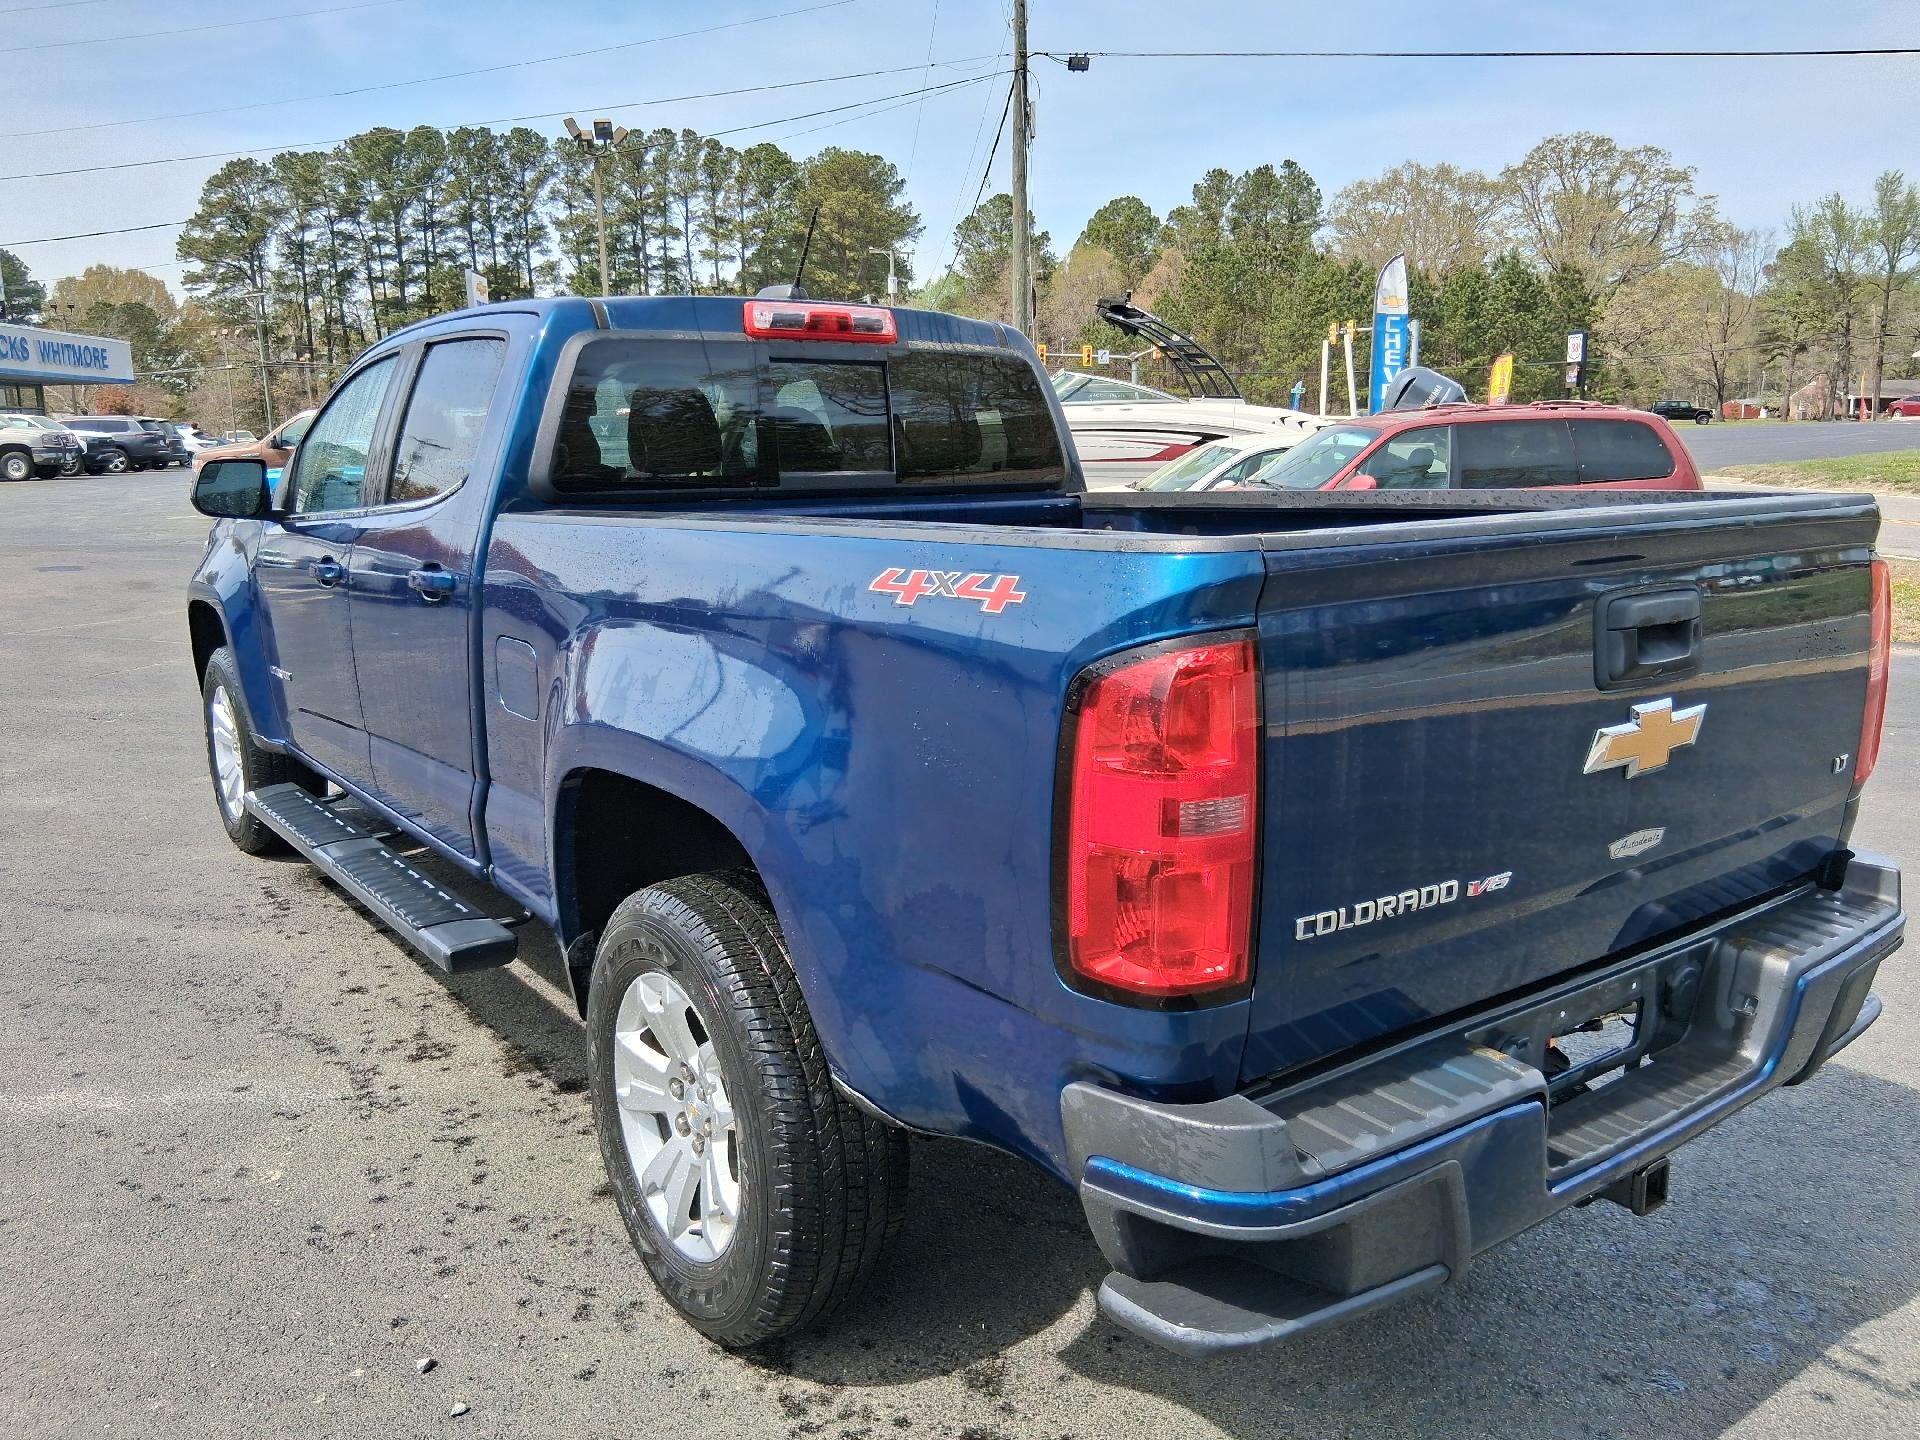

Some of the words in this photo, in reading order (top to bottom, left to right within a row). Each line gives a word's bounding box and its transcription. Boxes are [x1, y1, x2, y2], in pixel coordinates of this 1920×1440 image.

[38, 340, 109, 369] WHITMORE
[1832, 753, 1849, 775] LT
[1295, 879, 1459, 941] COLORADO
[1467, 871, 1513, 897] V6
